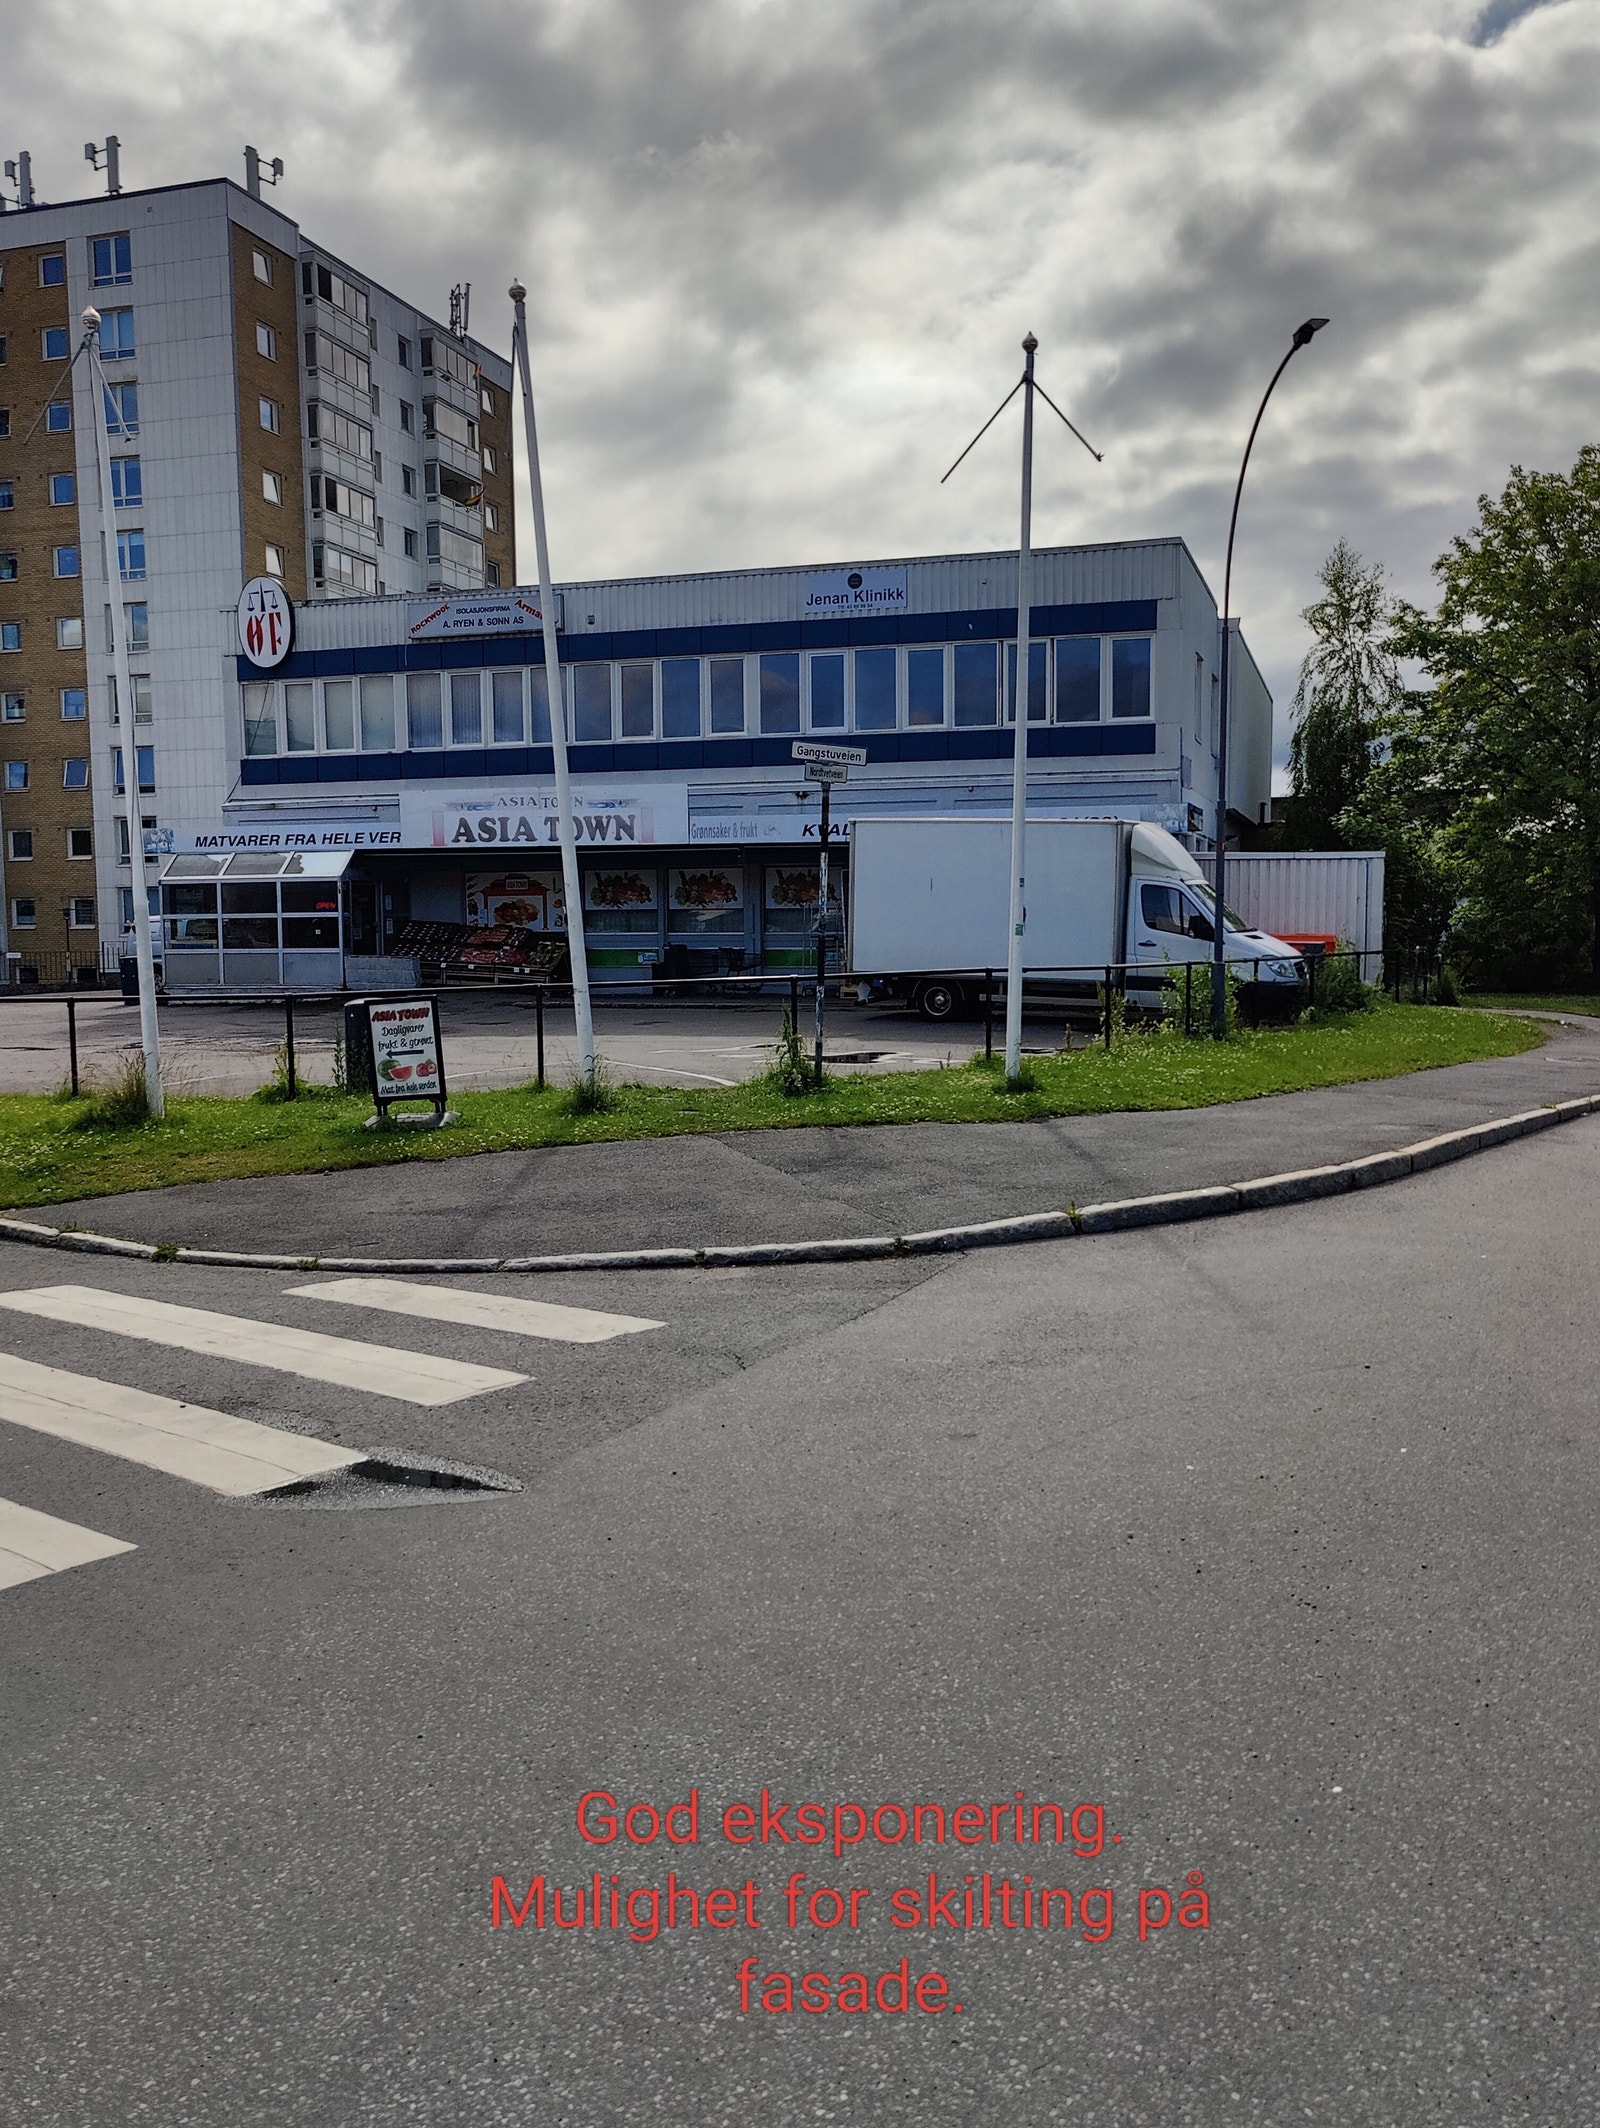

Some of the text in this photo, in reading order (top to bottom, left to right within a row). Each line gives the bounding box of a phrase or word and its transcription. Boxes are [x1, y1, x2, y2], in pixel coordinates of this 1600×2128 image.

[806, 588, 904, 606] Jenan Klinikk
[456, 605, 510, 614] ISOLASJONSFIRMA
[515, 599, 543, 620] Arma
[410, 603, 450, 634] ROCKWOOL
[453, 619, 475, 628] RYEN
[478, 618, 484, 626] &
[486, 617, 510, 626] SØNN
[513, 616, 524, 624] AS
[796, 745, 862, 761] Gangstuveien
[497, 796, 583, 808] ASIA TON
[451, 816, 538, 843] ASIA
[691, 824, 731, 839] Grønnsaker
[732, 823, 738, 836] &
[739, 822, 758, 838] frukt
[195, 831, 401, 848] MATVARER FRA HELE VER
[371, 1007, 430, 1022] ASIA TOWN
[382, 1024, 424, 1037] Dagligvarer
[378, 1040, 399, 1052] frukt
[400, 1038, 408, 1047] &
